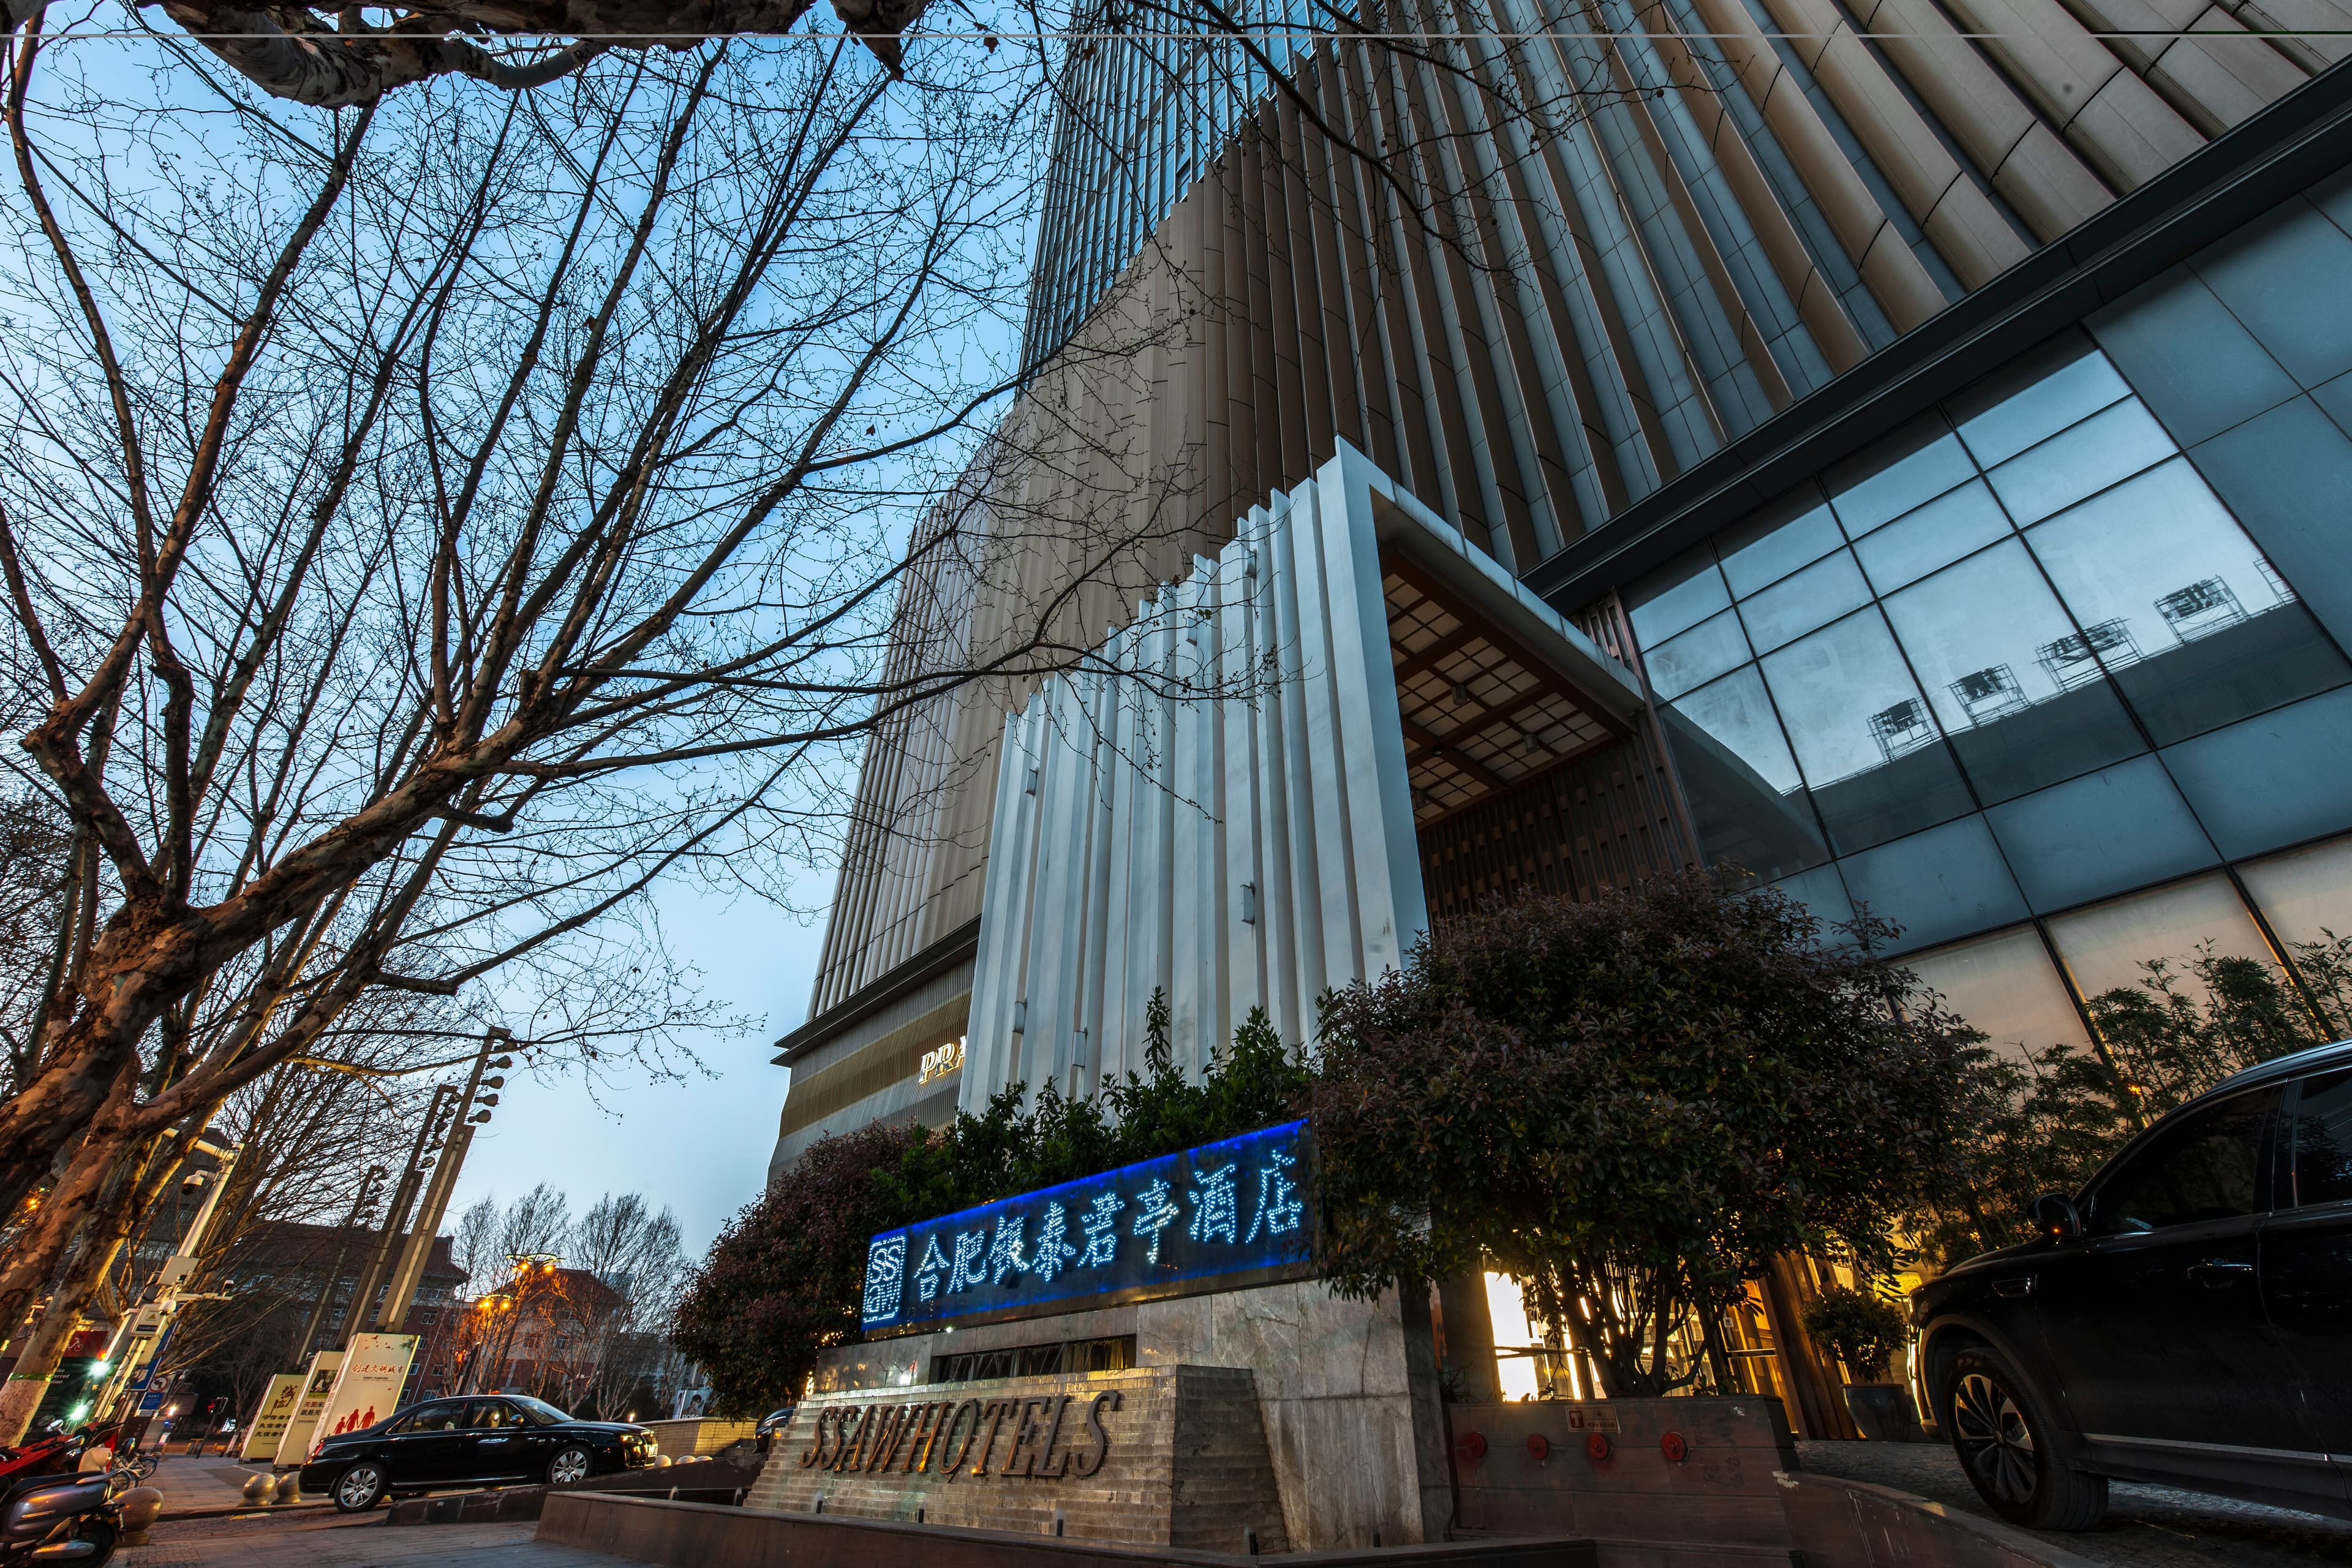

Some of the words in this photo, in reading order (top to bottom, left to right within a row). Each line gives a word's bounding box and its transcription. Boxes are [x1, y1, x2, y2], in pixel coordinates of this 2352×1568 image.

[352, 1363, 405, 1374] 创建文明城市
